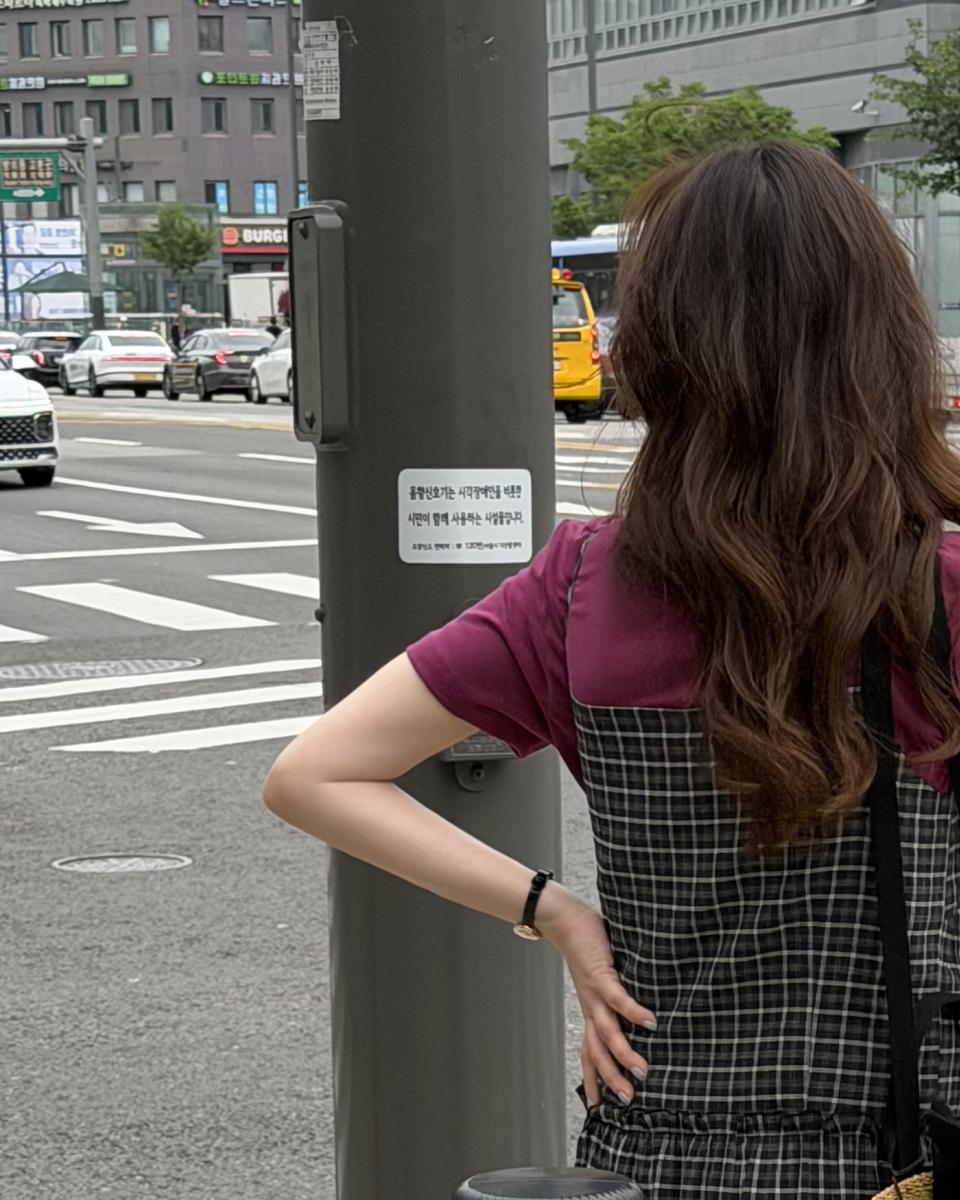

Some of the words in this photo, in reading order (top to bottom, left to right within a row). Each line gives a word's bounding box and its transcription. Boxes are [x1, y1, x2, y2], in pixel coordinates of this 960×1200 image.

[458, 485, 501, 499] 시각장애인을
[408, 512, 430, 527] 시민이
[432, 512, 449, 527] 함께
[451, 512, 483, 526] 사용하는
